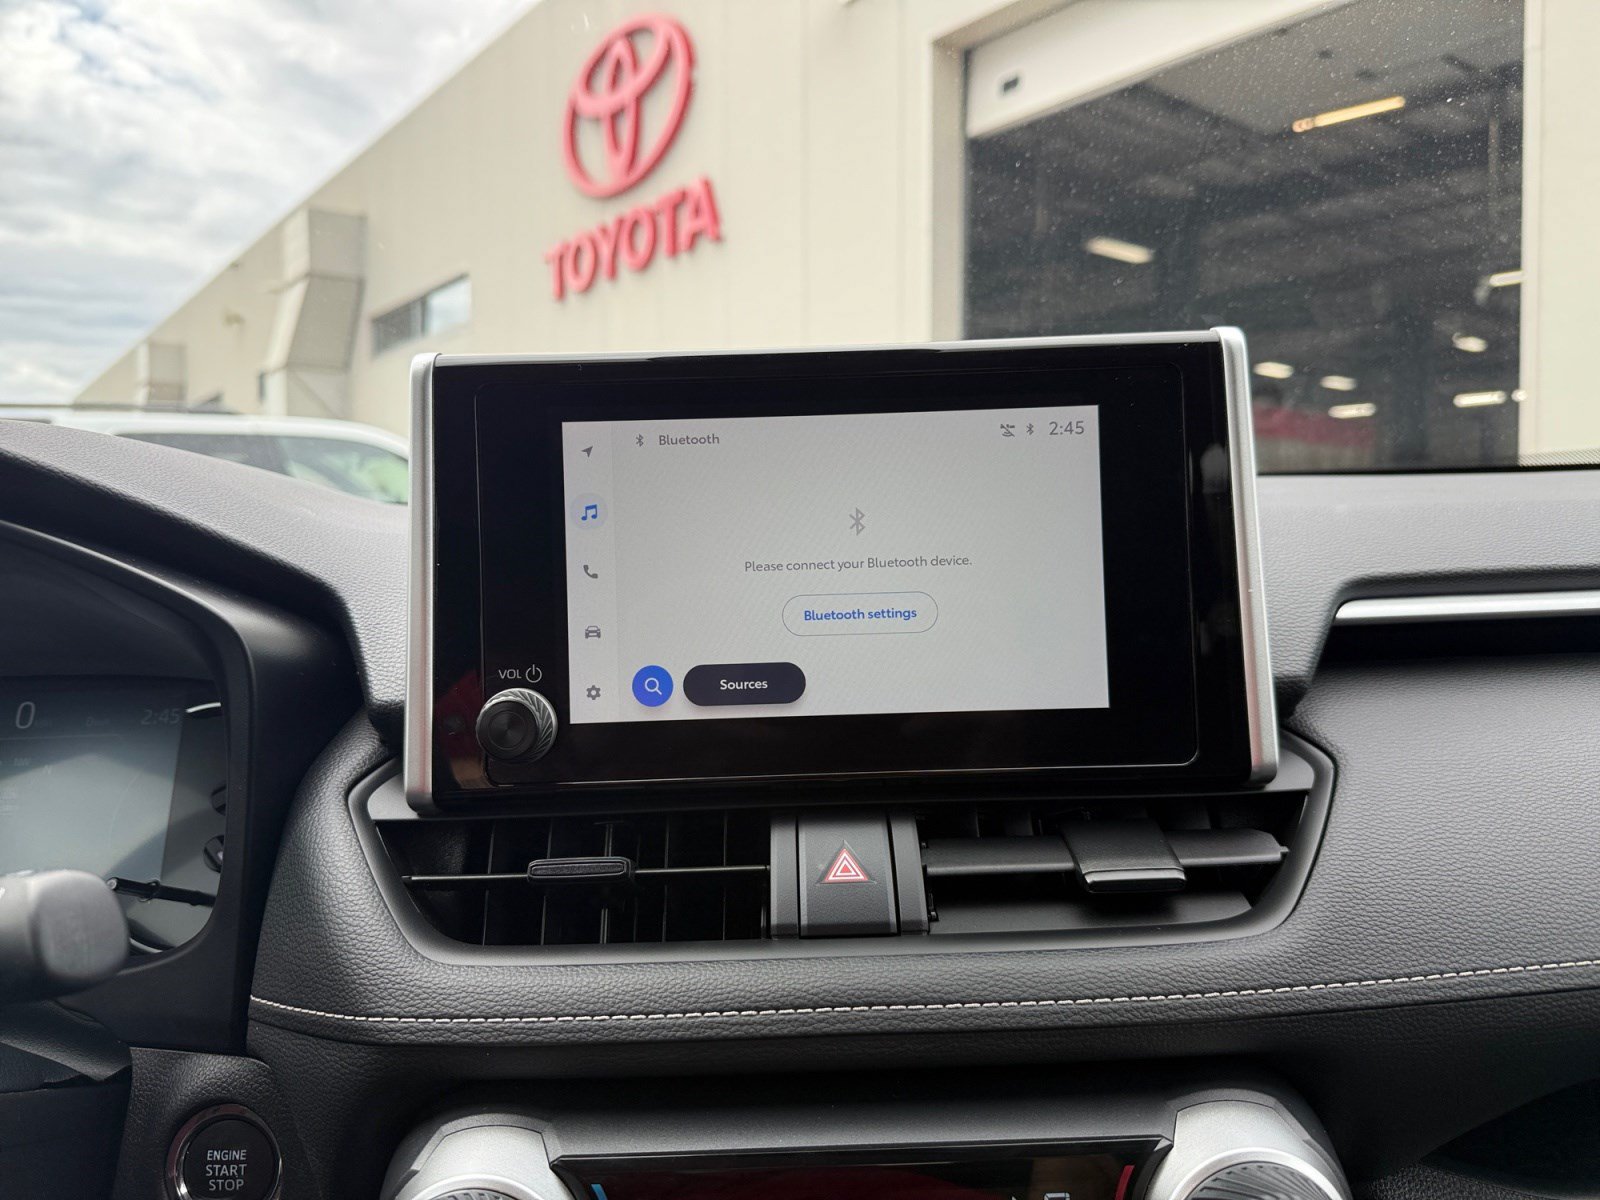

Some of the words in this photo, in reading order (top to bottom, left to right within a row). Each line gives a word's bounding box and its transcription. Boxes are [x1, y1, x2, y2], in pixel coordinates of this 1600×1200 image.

[544, 174, 721, 302] TOYOTA
[1048, 420, 1085, 436] 2:45
[658, 433, 720, 446] Bluetooth
[744, 560, 784, 572] Please
[786, 559, 836, 572] connect
[837, 560, 864, 572] your
[867, 556, 928, 569] Bluetooth
[930, 555, 973, 567] device.
[803, 608, 865, 621] Bluetooth
[867, 607, 917, 621] settings
[498, 668, 522, 679] VOL
[719, 678, 768, 691] Sources
[15, 701, 36, 729] 0
[140, 708, 181, 725] 2:45
[206, 1149, 247, 1161] ENGINE
[205, 1164, 248, 1177] START
[208, 1179, 245, 1191] STOP
